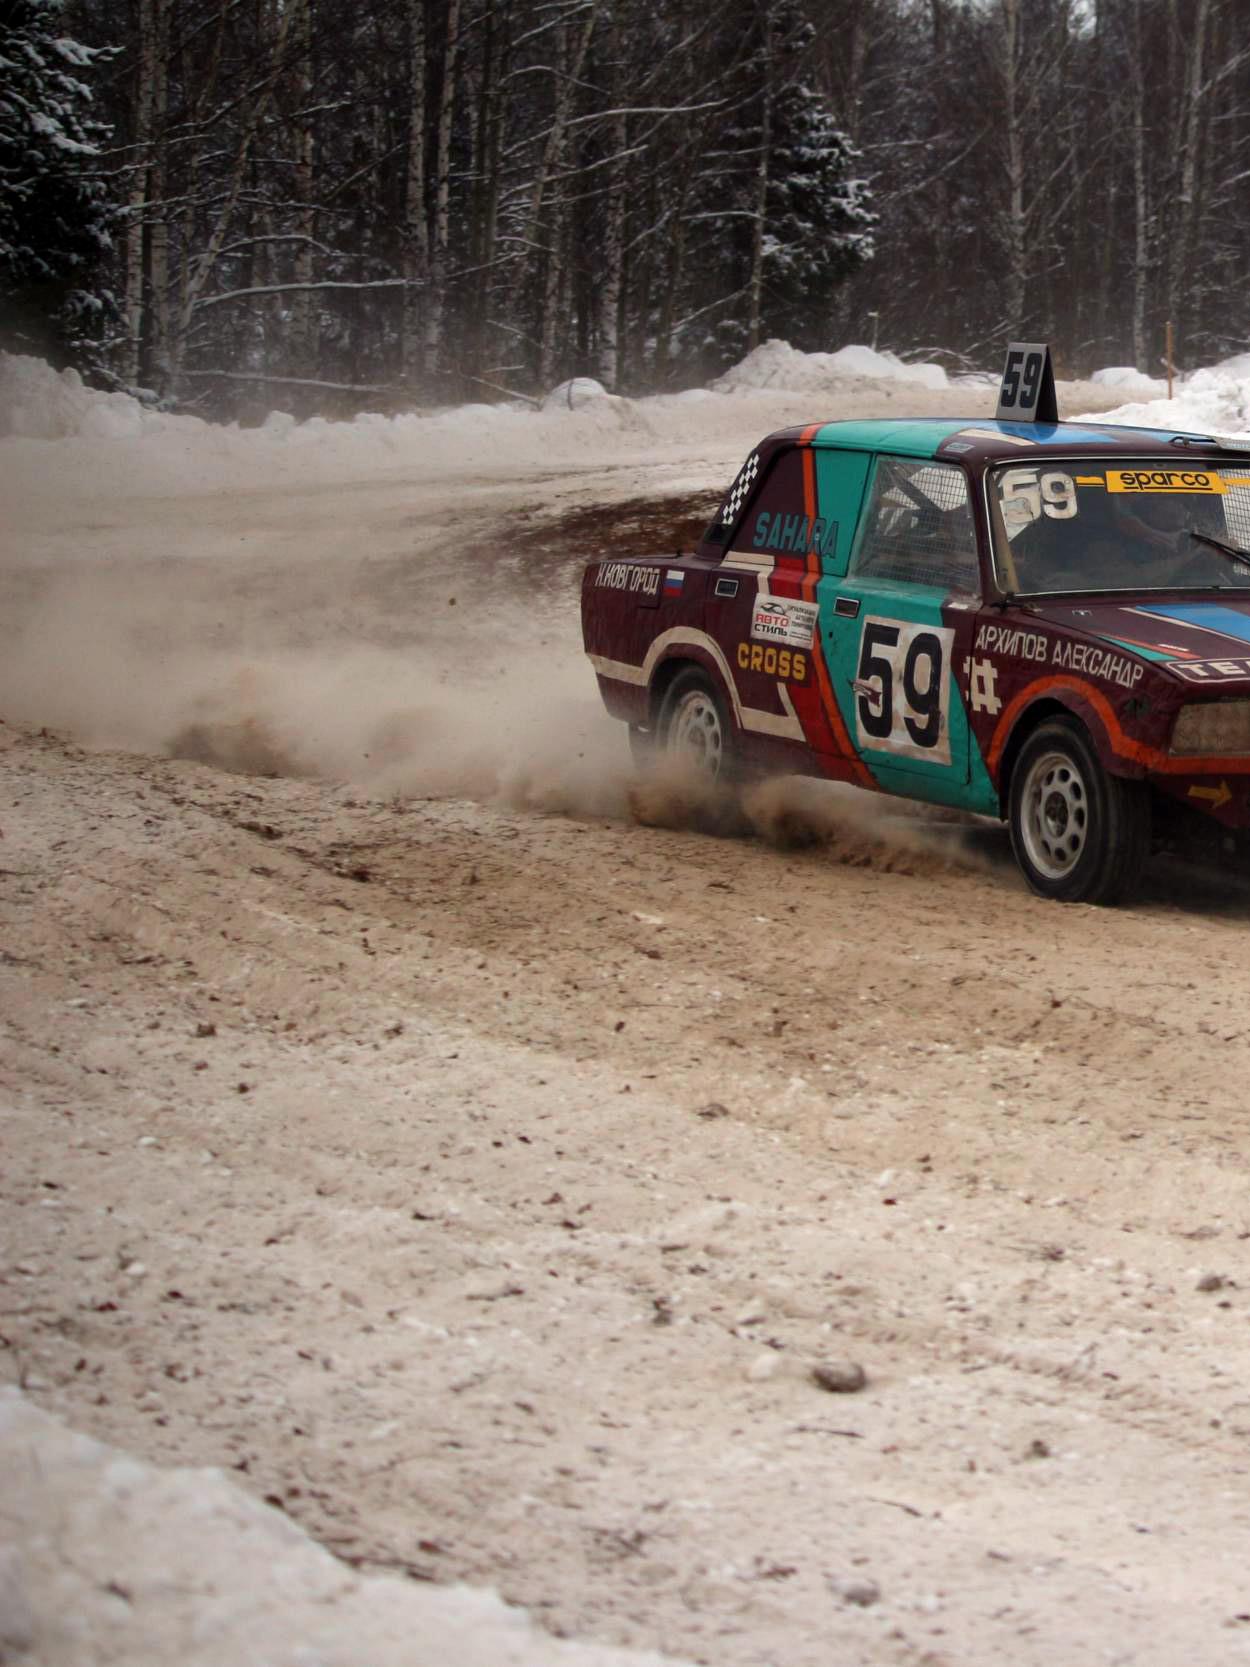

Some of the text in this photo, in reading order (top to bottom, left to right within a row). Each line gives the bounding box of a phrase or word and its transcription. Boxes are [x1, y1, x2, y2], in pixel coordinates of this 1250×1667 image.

[1001, 352, 1042, 408] 59
[1000, 468, 1077, 524] 59
[1120, 471, 1210, 490] sparco
[753, 511, 840, 559] SAHARA
[754, 624, 787, 636] СТИЛЬ
[756, 613, 789, 627] АВТО
[738, 643, 806, 680] CROSS
[975, 625, 1144, 688] АРХИПОВ АЛЕКСАНДР
[858, 622, 942, 748] 59
